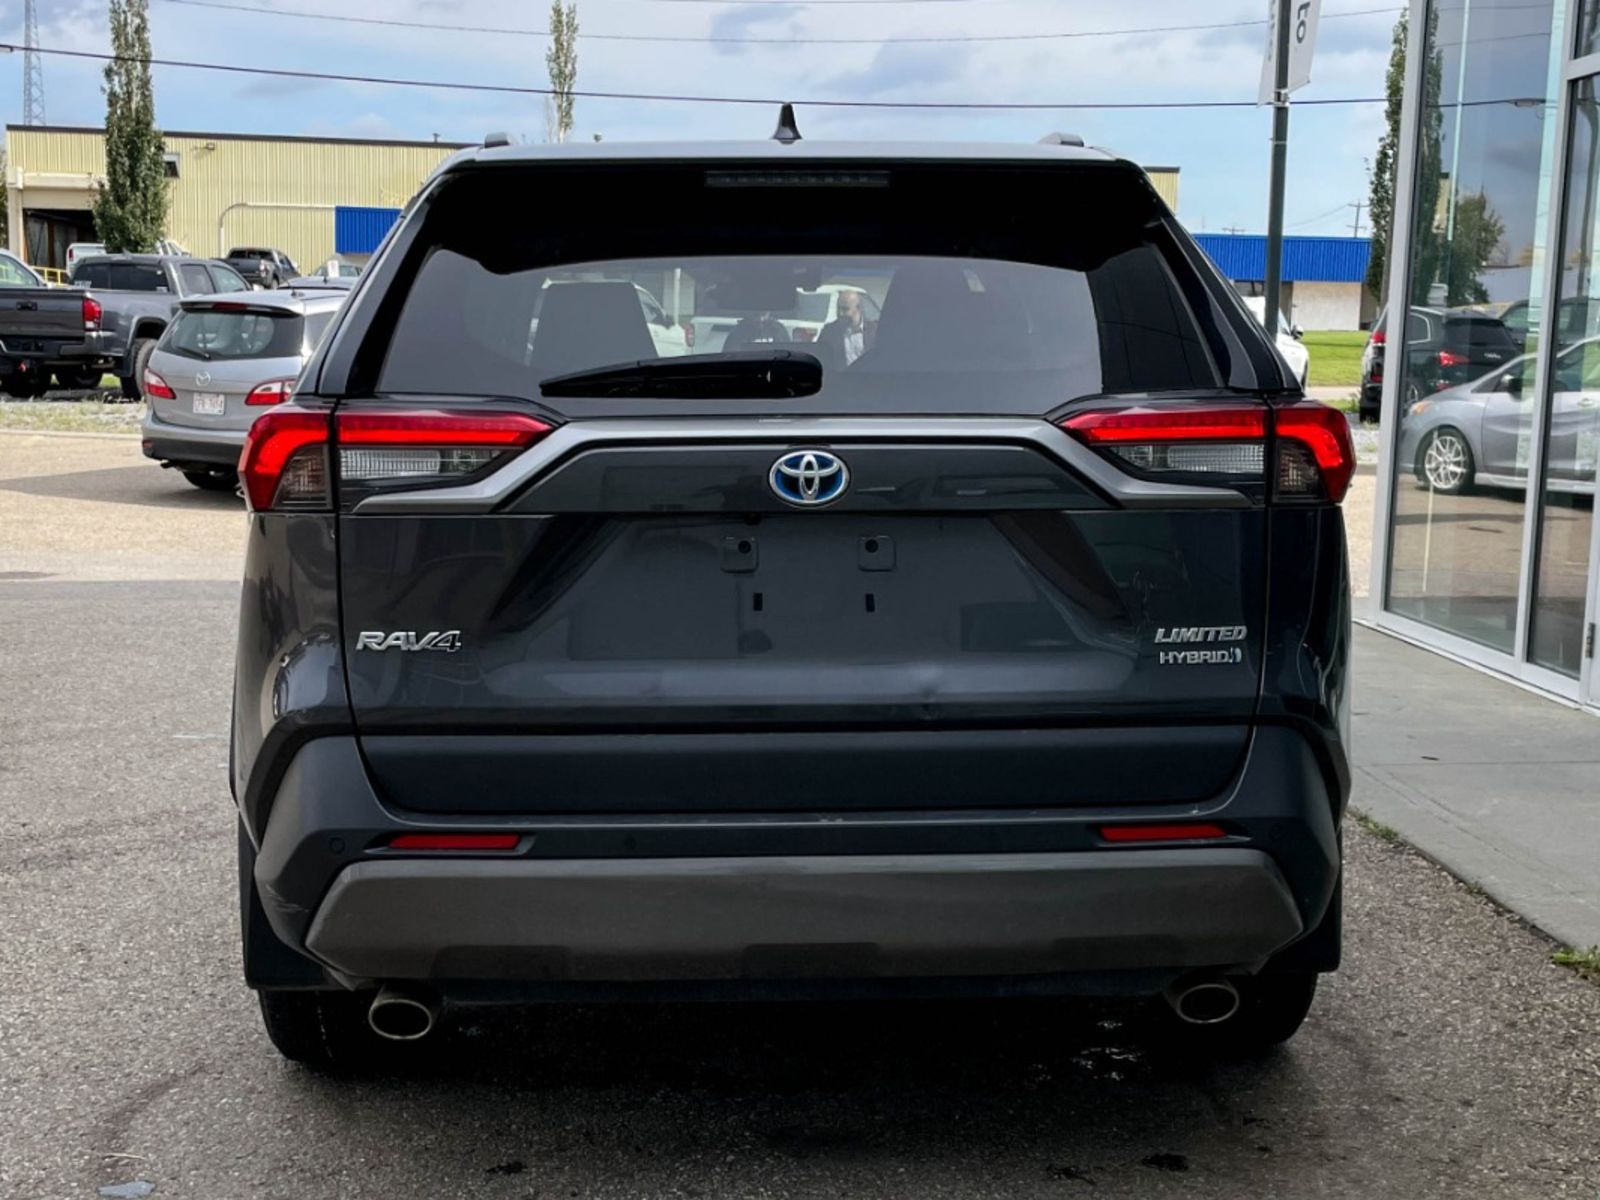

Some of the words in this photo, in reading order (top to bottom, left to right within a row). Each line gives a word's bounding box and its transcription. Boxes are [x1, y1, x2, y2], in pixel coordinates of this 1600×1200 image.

[355, 630, 462, 652] RAV4
[1154, 625, 1248, 643] LIMITED
[1159, 650, 1230, 665] HYBRID
